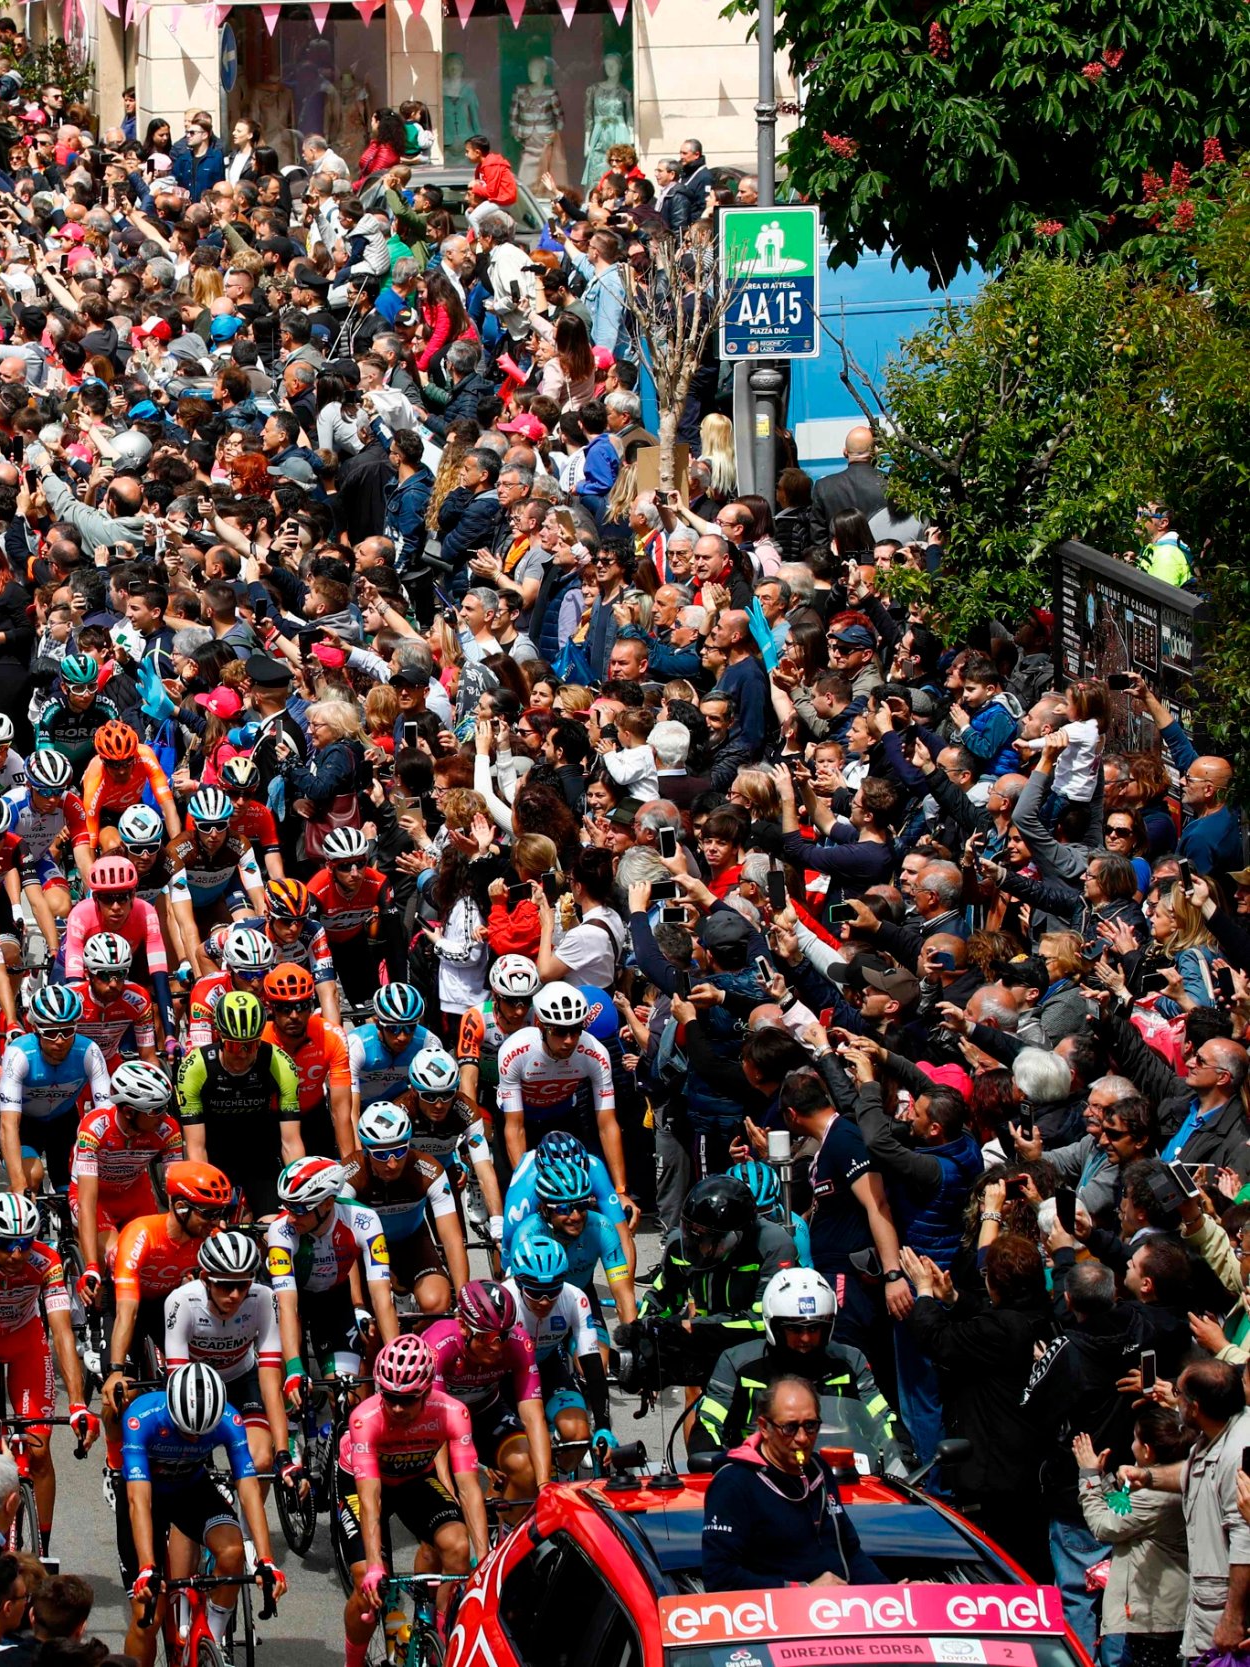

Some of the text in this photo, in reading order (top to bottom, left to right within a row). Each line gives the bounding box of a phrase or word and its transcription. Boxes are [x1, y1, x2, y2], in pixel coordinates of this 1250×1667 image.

[738, 291, 802, 326] AA 15
[1096, 582, 1121, 603] COMUNE
[1123, 595, 1129, 605] DI
[1131, 598, 1158, 619] CASSINO
[504, 1043, 531, 1067] GIANT
[584, 1049, 610, 1071] GIANT
[210, 1098, 266, 1108] MITCHELTON
[354, 1220, 371, 1231] PRO
[800, 1301, 815, 1310] Rai
[191, 1337, 248, 1350] ACADEMY
[667, 1588, 1051, 1640] enel enel enel
[780, 1645, 924, 1660] DIREZIONE CORSA
[941, 1655, 981, 1663] TOYOTA
[1003, 1648, 1014, 1659] 2
